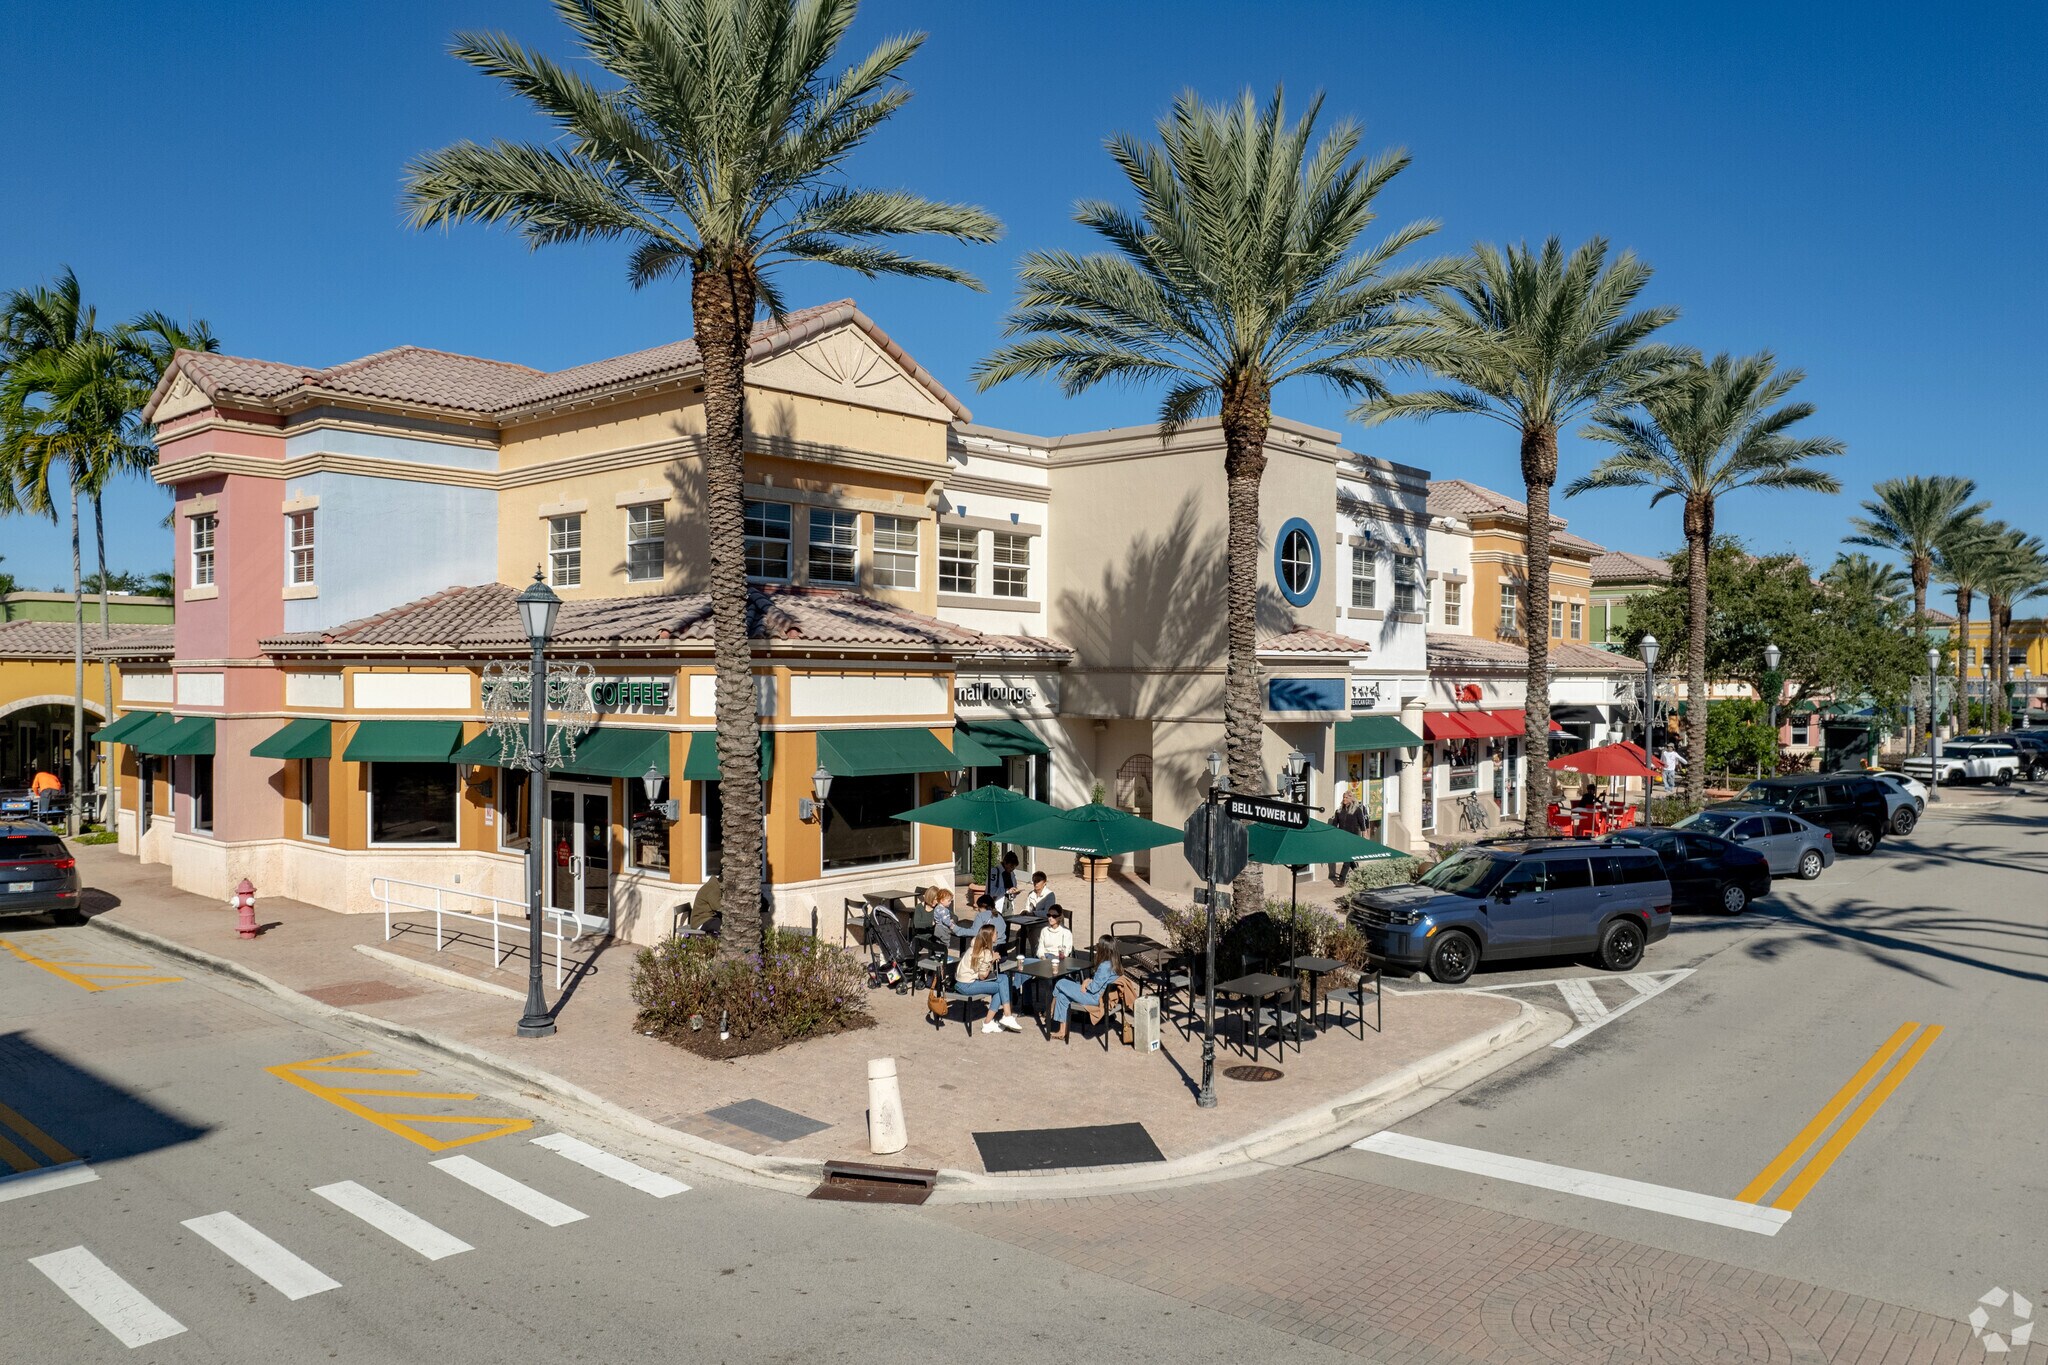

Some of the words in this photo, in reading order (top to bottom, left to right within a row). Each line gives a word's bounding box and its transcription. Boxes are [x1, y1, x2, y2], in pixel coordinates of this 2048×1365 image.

[591, 682, 665, 707] COFFEE
[958, 682, 983, 701] nail
[987, 683, 1033, 704] lounge
[1232, 801, 1253, 816] BELL
[1254, 806, 1286, 822] TOWER
[1287, 812, 1303, 825] LN.
